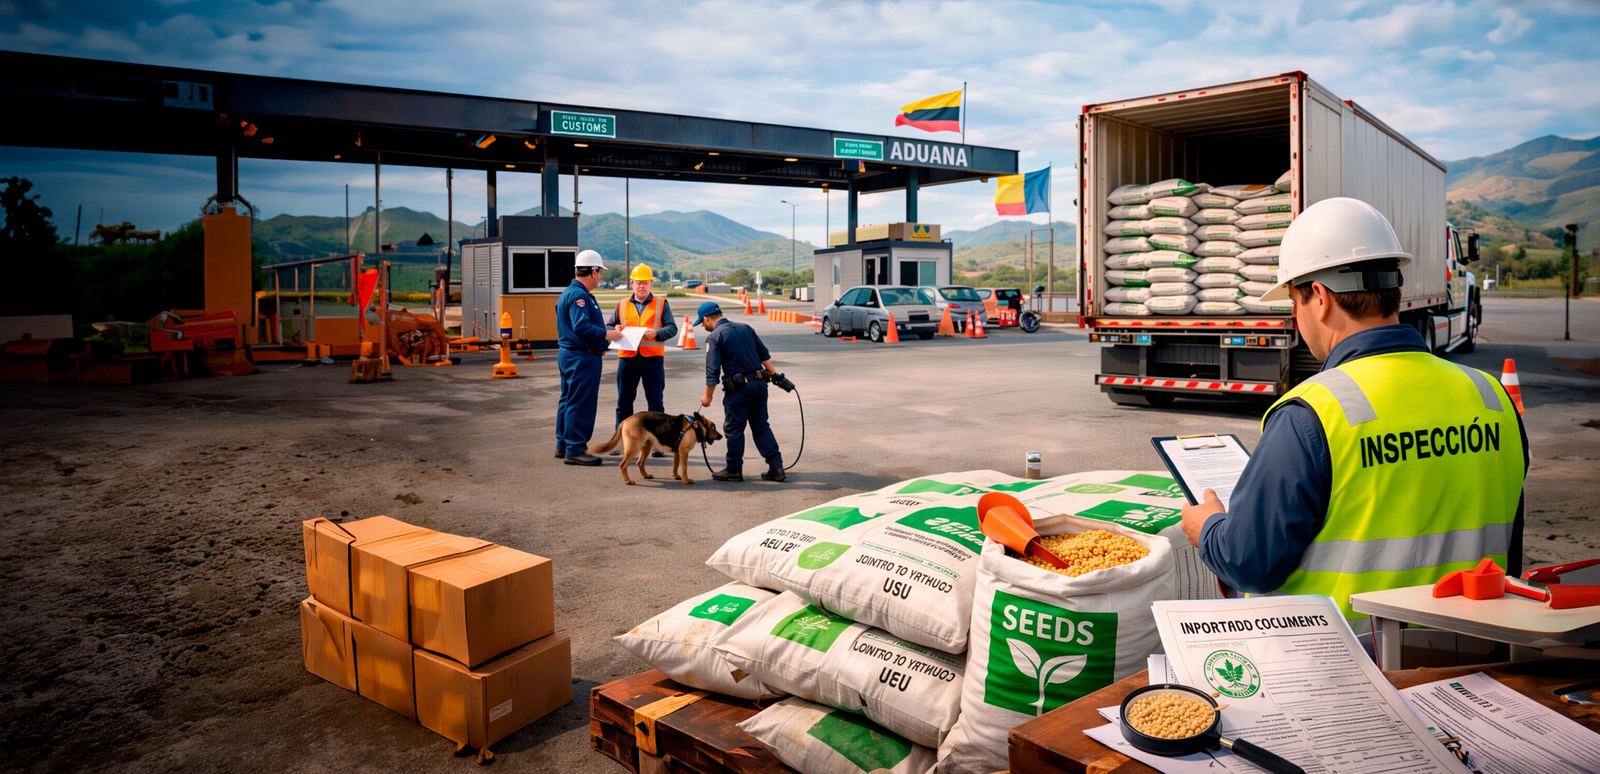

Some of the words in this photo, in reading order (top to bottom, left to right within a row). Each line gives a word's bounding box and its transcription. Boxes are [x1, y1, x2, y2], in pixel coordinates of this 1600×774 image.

[562, 121, 607, 133] CUSTOMS
[890, 141, 968, 167] ADUANA
[1360, 416, 1500, 468] INSPECCIÓN
[883, 577, 912, 600] USU
[1002, 604, 1094, 645] SEEDS
[1180, 620, 1253, 635] INPORTADO
